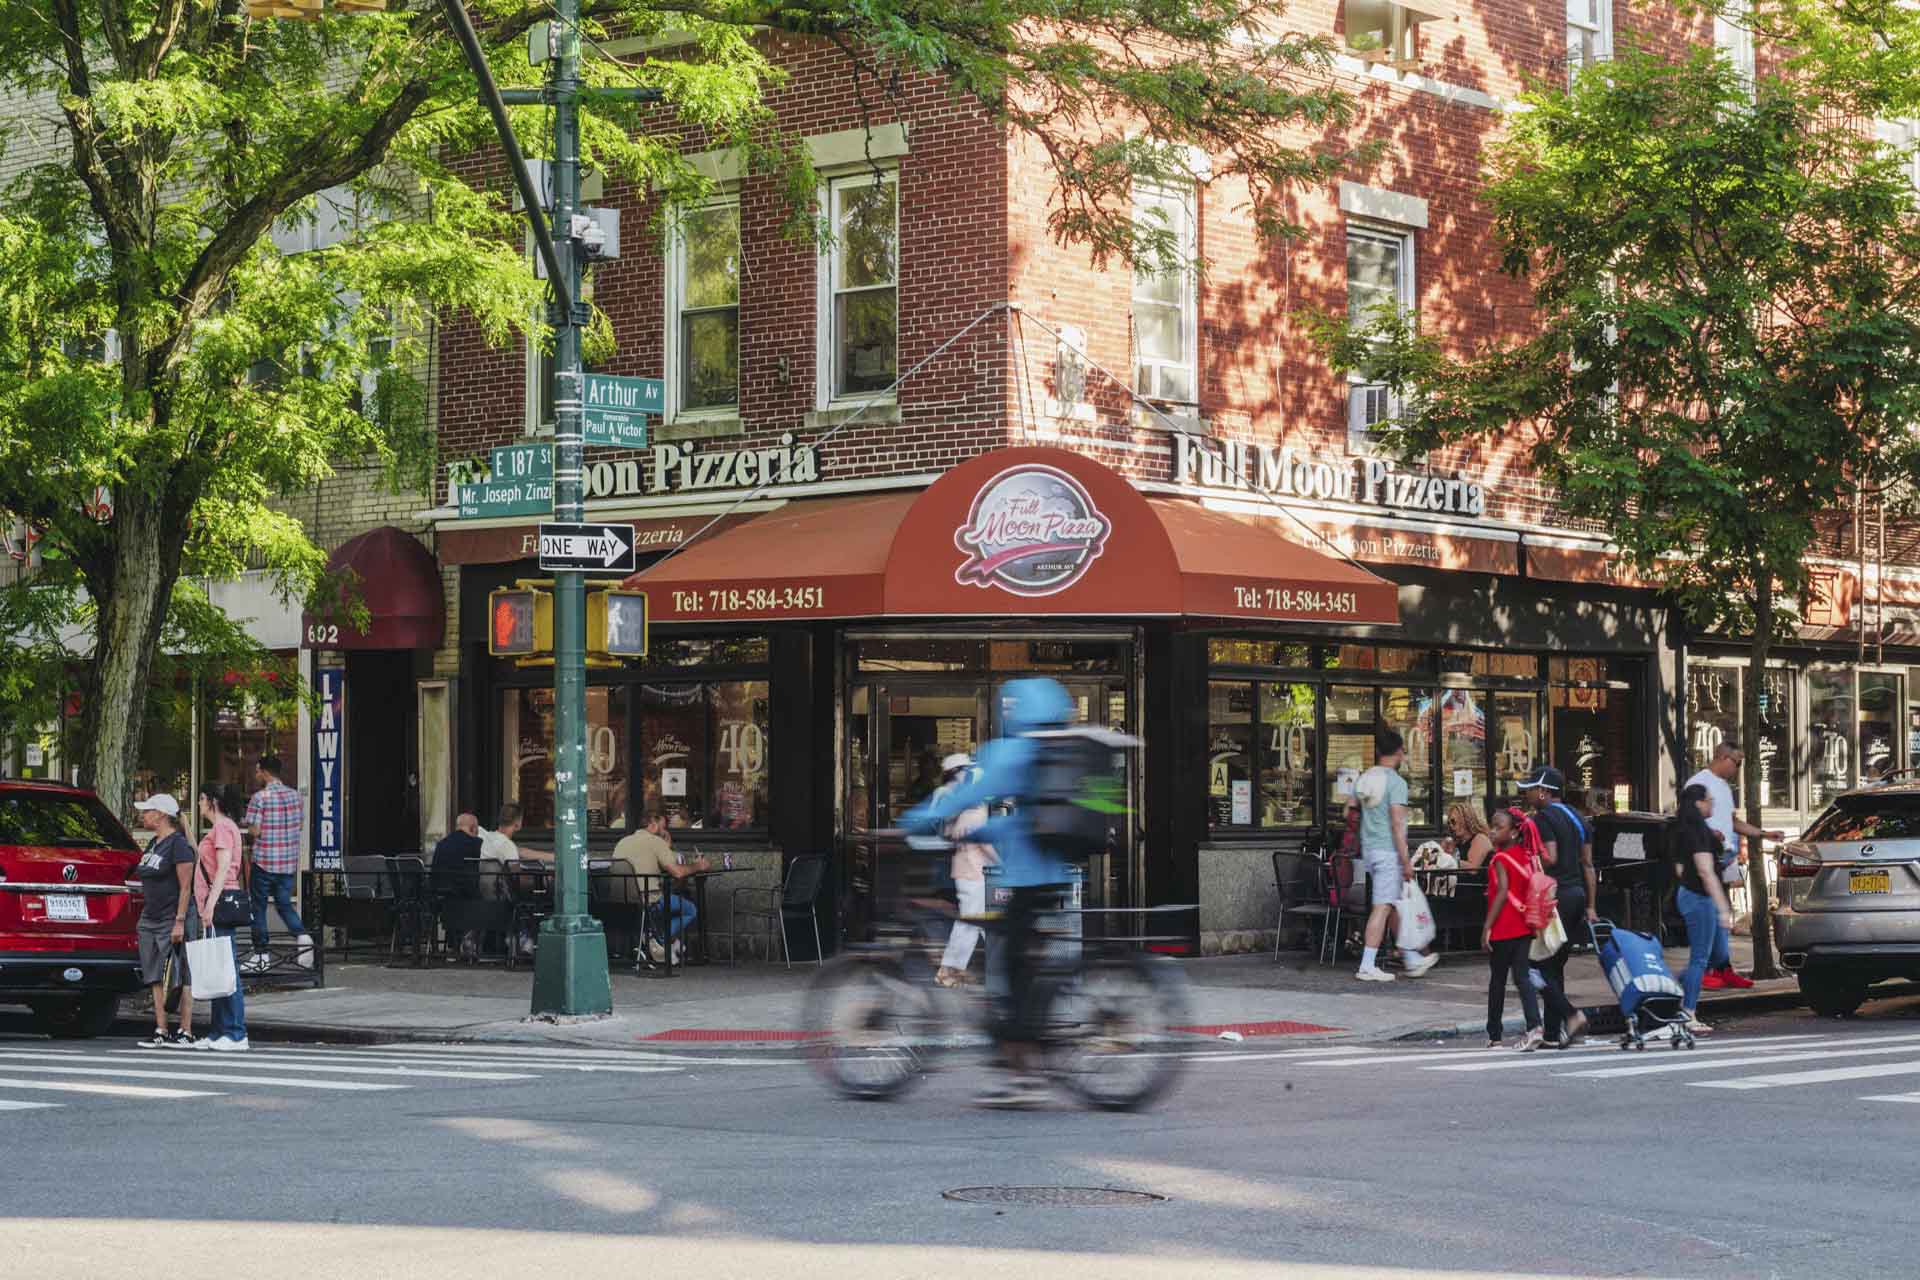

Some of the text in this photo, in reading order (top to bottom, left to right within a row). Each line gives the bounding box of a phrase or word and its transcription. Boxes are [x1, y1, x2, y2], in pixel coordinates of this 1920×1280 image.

[588, 379, 658, 406] Arthur Av
[586, 419, 643, 437] Paul A Victor
[496, 449, 553, 477] E 187 St
[651, 433, 818, 492] Pizzeria
[1173, 433, 1485, 515] Full Moon Pizzeria
[462, 487, 479, 505] Mr.
[482, 486, 521, 505] Joseph
[1008, 498, 1040, 516] Full
[970, 512, 1098, 542] Moon Pizza
[544, 538, 619, 556] ONE WAY
[1383, 537, 1440, 560] Pizzeria
[672, 587, 824, 613] Tel: 718-584-3451
[1234, 587, 1358, 613] Tel: 718-584-3451
[308, 624, 338, 644] 602
[316, 673, 338, 848] LAWYER
[719, 723, 763, 774] 40
[1270, 725, 1307, 772] 40
[1502, 728, 1533, 773] 40
[1823, 735, 1848, 775] 40
[1214, 767, 1225, 785] A
